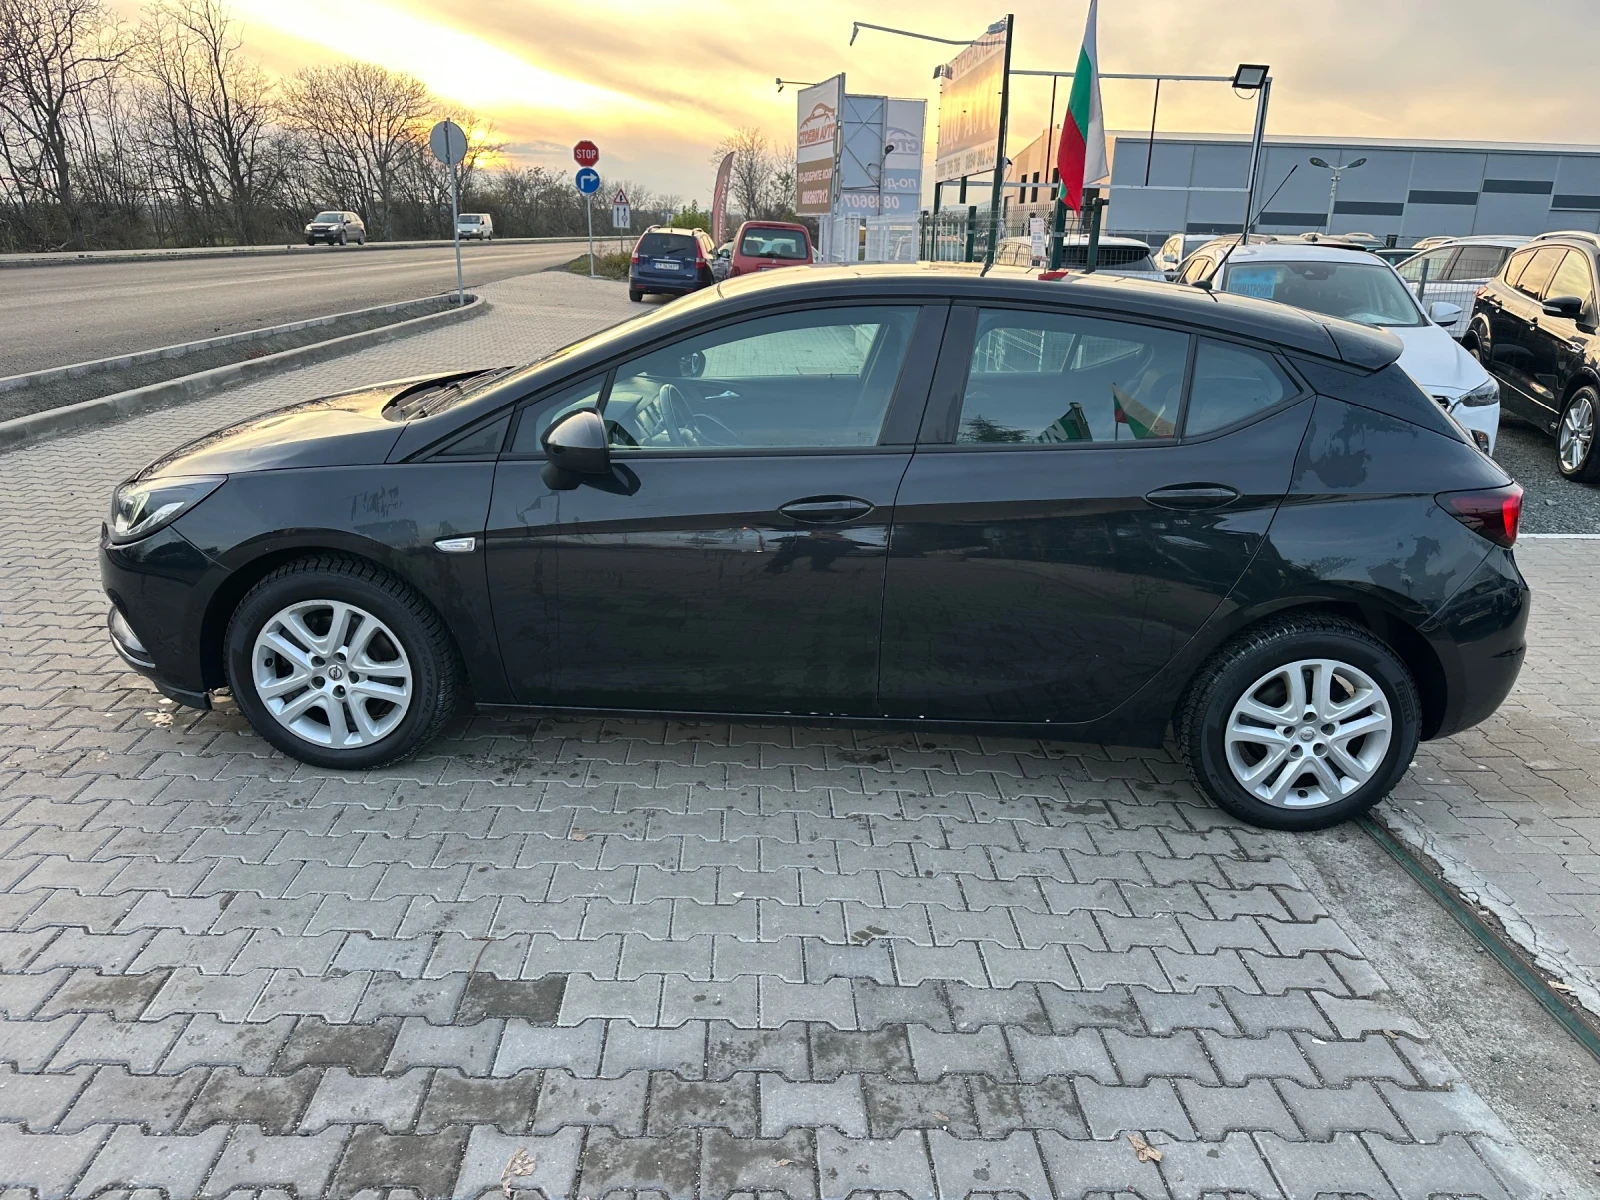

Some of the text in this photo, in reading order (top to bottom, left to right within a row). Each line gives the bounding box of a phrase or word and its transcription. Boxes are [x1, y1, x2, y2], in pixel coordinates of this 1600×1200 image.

[799, 122, 835, 145] СТОЕВИ АУТО
[576, 149, 596, 159] STOP
